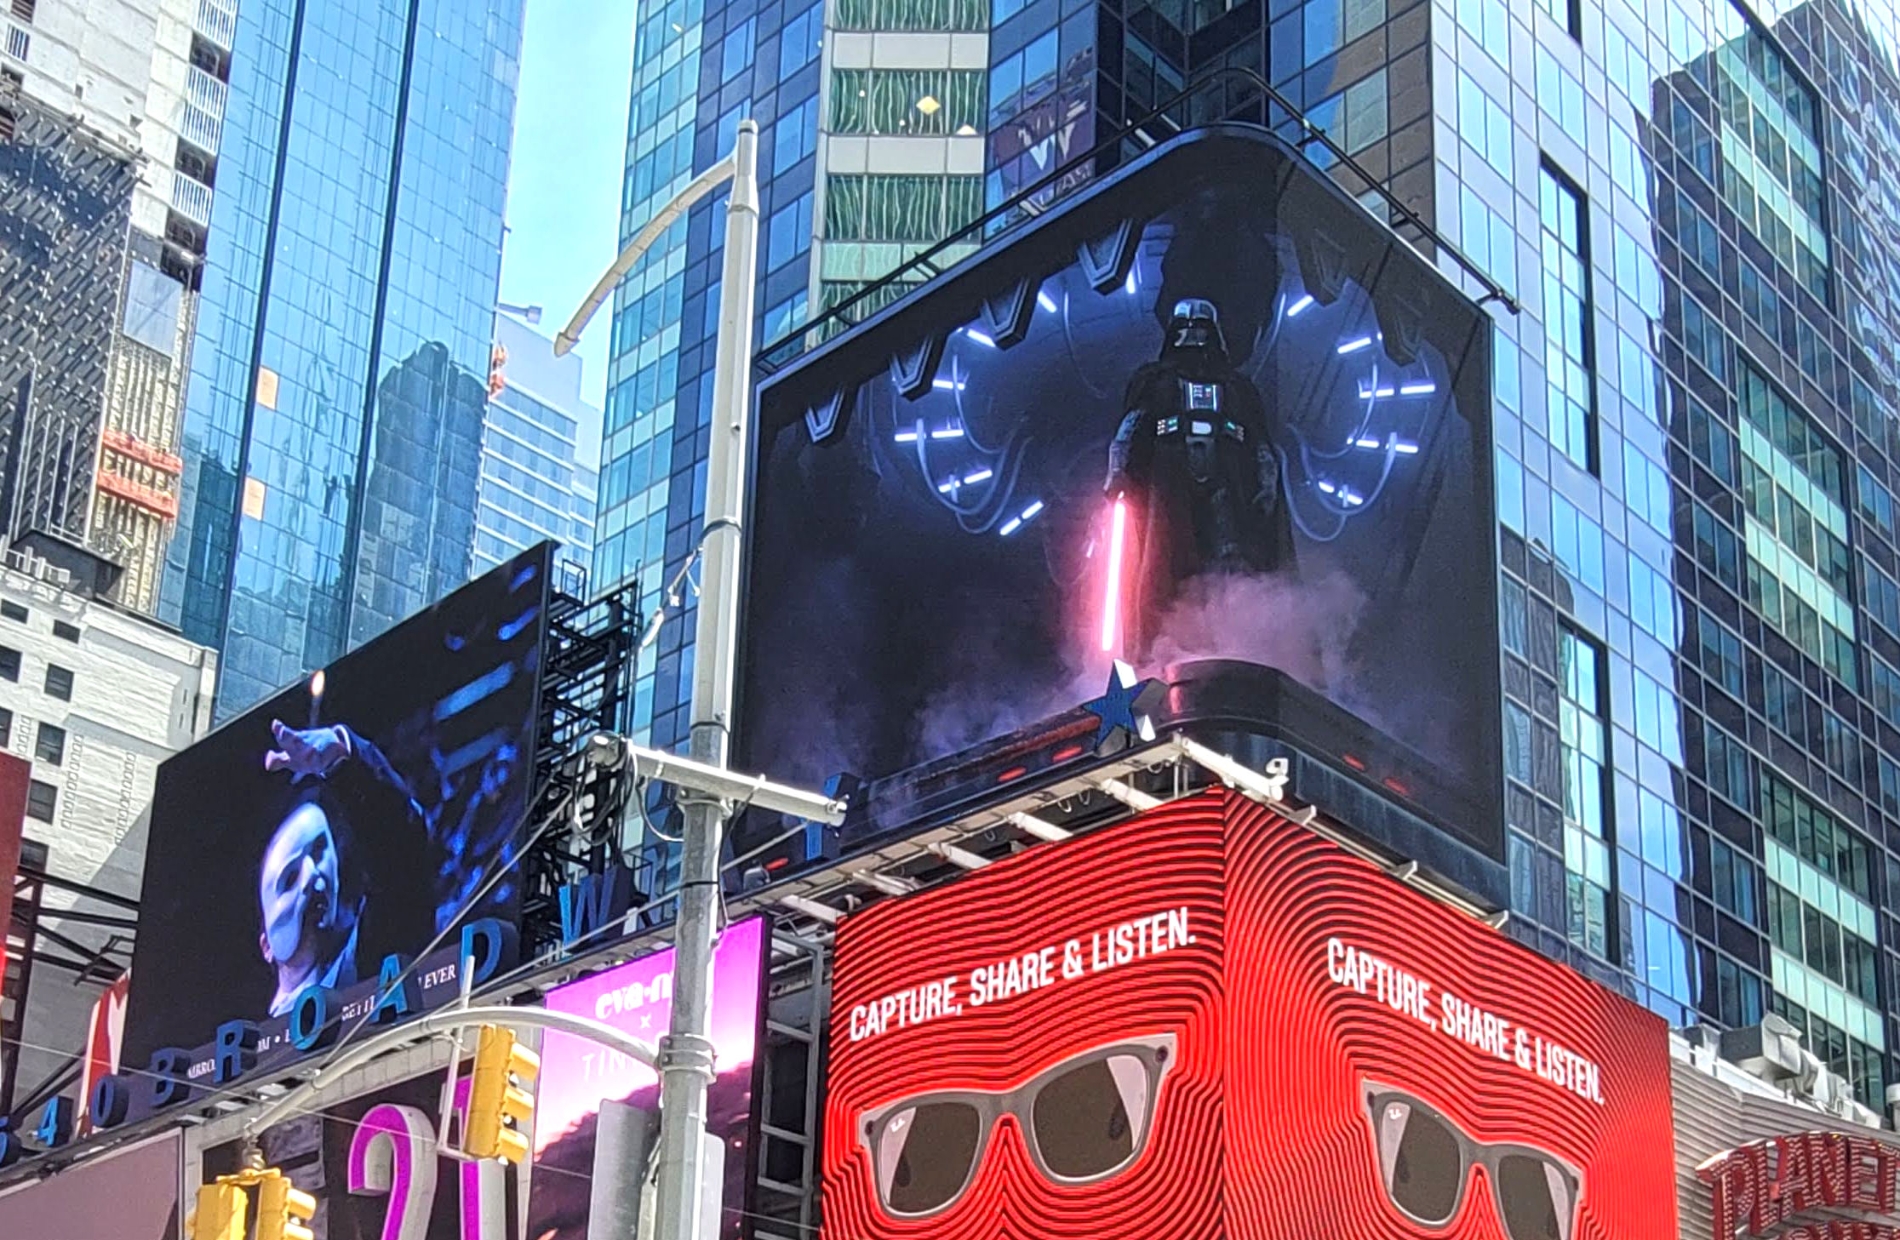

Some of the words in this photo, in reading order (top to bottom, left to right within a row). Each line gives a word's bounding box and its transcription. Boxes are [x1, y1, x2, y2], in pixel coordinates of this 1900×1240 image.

[850, 975, 962, 1042] CAPTURE,
[970, 946, 1055, 1007] SHARE
[1062, 938, 1084, 980] &
[1091, 906, 1197, 971] LISTEN.
[1327, 936, 1437, 1032] CAPTURE,
[1441, 992, 1511, 1061] SHARE
[1515, 1028, 1532, 1071] &
[1535, 1035, 1605, 1105] LISTEN.
[1695, 1132, 1900, 1240] PLANET
